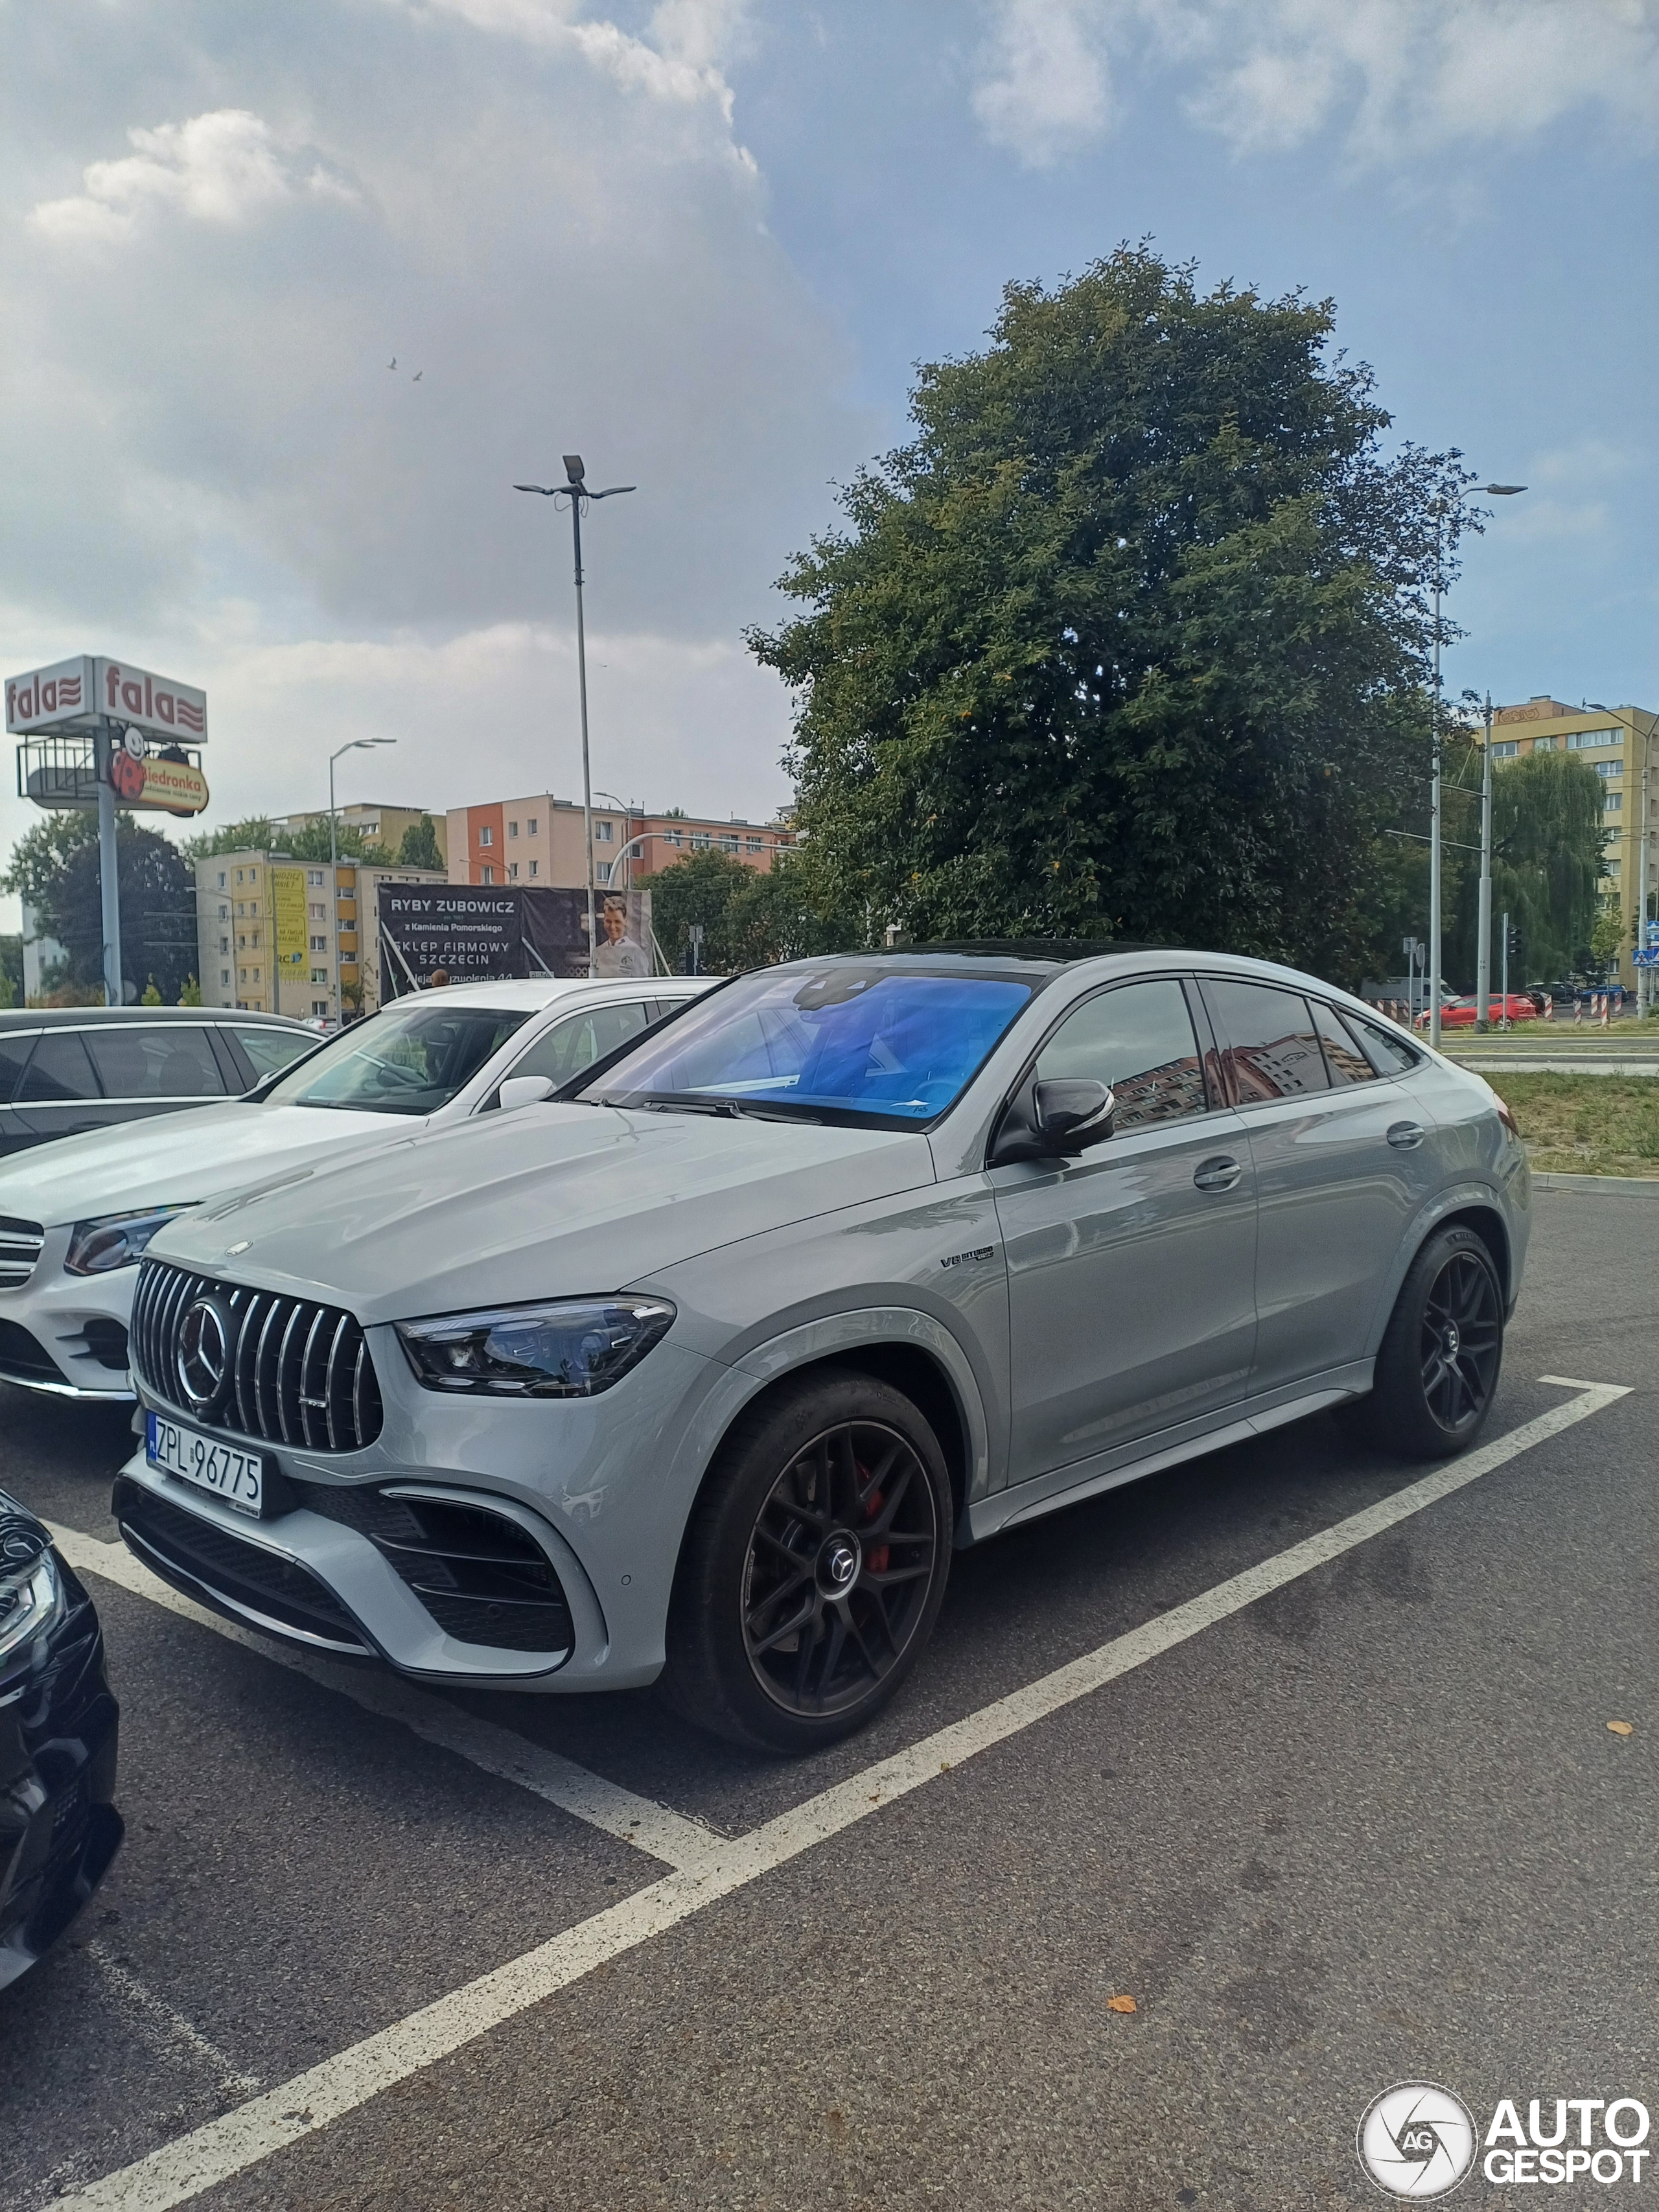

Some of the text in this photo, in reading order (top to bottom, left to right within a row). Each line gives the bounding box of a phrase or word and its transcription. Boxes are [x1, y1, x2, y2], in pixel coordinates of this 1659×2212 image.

[7, 674, 56, 725] fala
[106, 666, 175, 725] fala
[391, 899, 515, 913] RYBY ZUBOWICZ
[412, 923, 449, 931] Kamienia
[451, 924, 502, 933] Pomorskiego
[444, 942, 509, 952] FIRMOWY
[419, 954, 489, 964] SZCZECIN
[406, 973, 433, 984] leja
[157, 1421, 259, 1500] ZPL 96775
